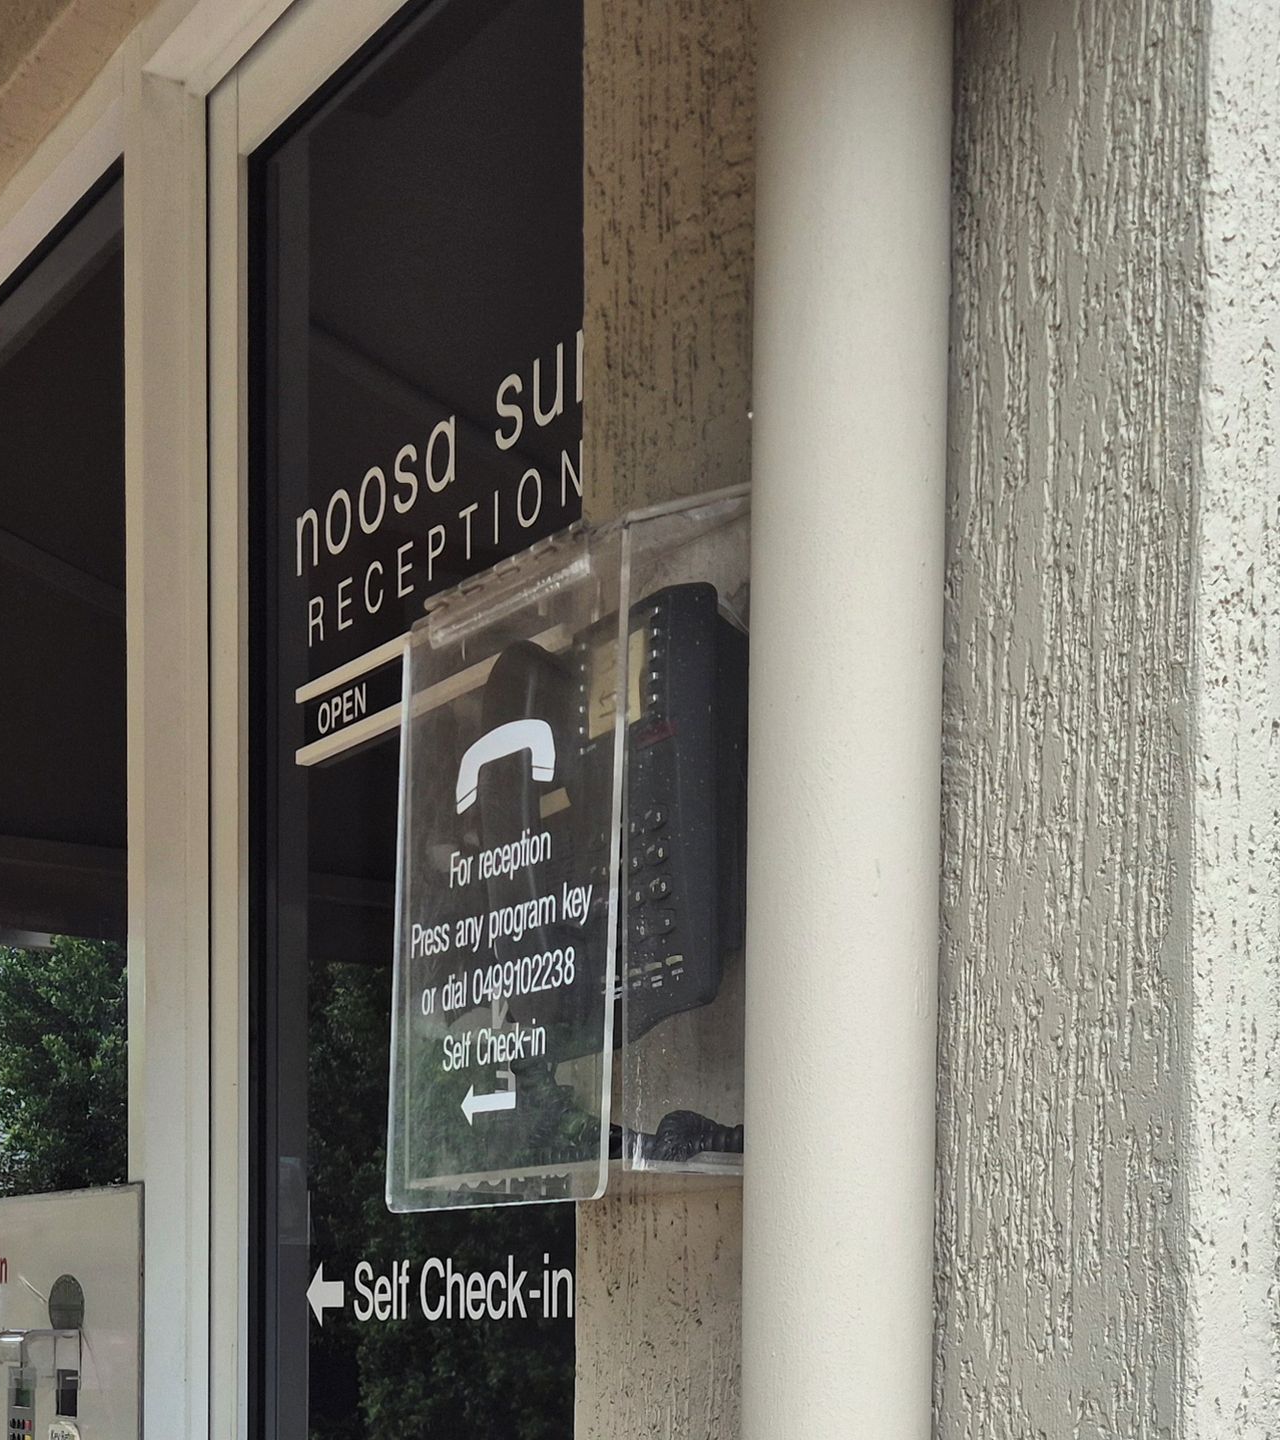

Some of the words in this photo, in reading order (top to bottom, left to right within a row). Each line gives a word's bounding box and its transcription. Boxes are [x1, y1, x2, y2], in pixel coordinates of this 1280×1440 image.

[296, 414, 456, 577] noosa
[308, 439, 584, 648] RECEPTION
[317, 682, 367, 734] OPEN
[449, 851, 473, 889] For
[478, 828, 551, 881] reception
[411, 923, 450, 960] Press
[455, 914, 484, 953] any
[488, 893, 556, 949] program
[562, 881, 593, 927] key
[421, 986, 437, 1016] or
[442, 970, 467, 1012] dial
[472, 945, 576, 1005] 0499102238
[442, 1030, 472, 1072] Self
[476, 1018, 546, 1066] Check-in
[353, 1259, 410, 1322] Self
[420, 1252, 573, 1321] Check-in
